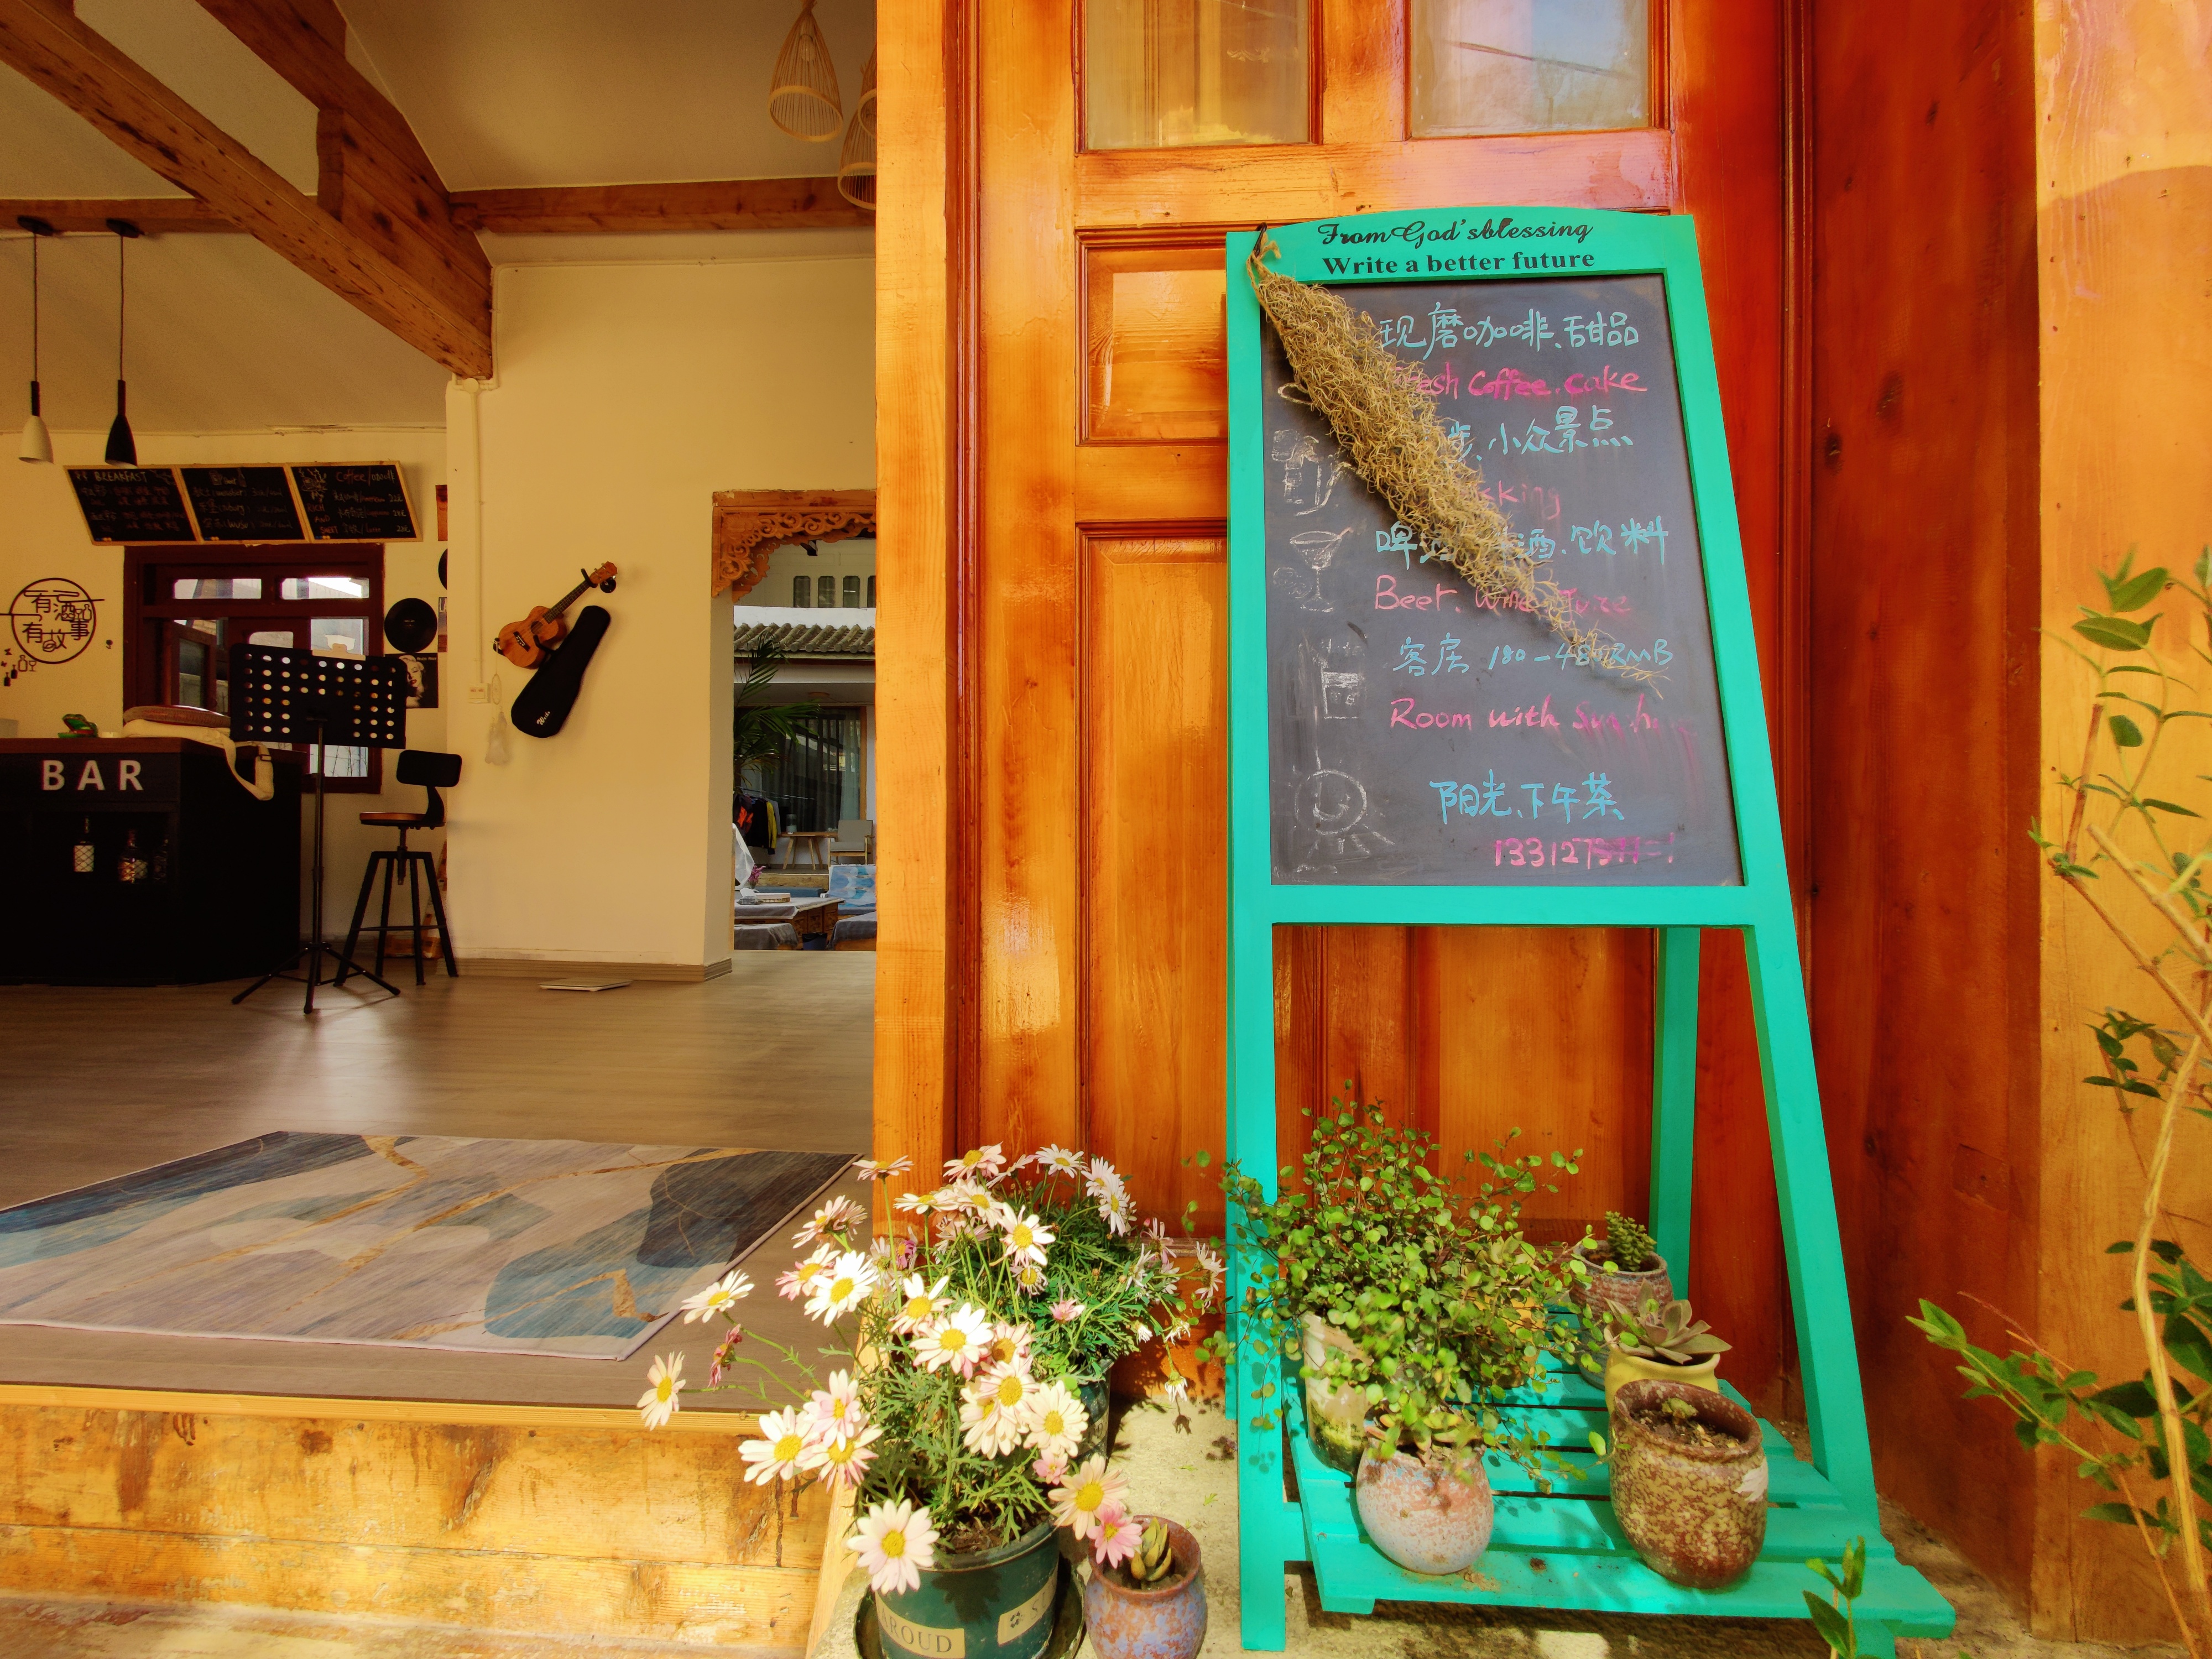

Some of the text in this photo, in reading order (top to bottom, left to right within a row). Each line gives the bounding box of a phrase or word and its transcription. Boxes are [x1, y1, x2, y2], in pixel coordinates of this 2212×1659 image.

[1317, 223, 1391, 244] From
[1322, 252, 1595, 275] Write a better future
[1425, 405, 1633, 465] 步、小众景点
[94, 471, 148, 483] BREAKFAST
[306, 503, 325, 513] RICH
[1390, 698, 1472, 731] Room
[1489, 694, 1561, 728] with
[43, 760, 144, 791] BAR
